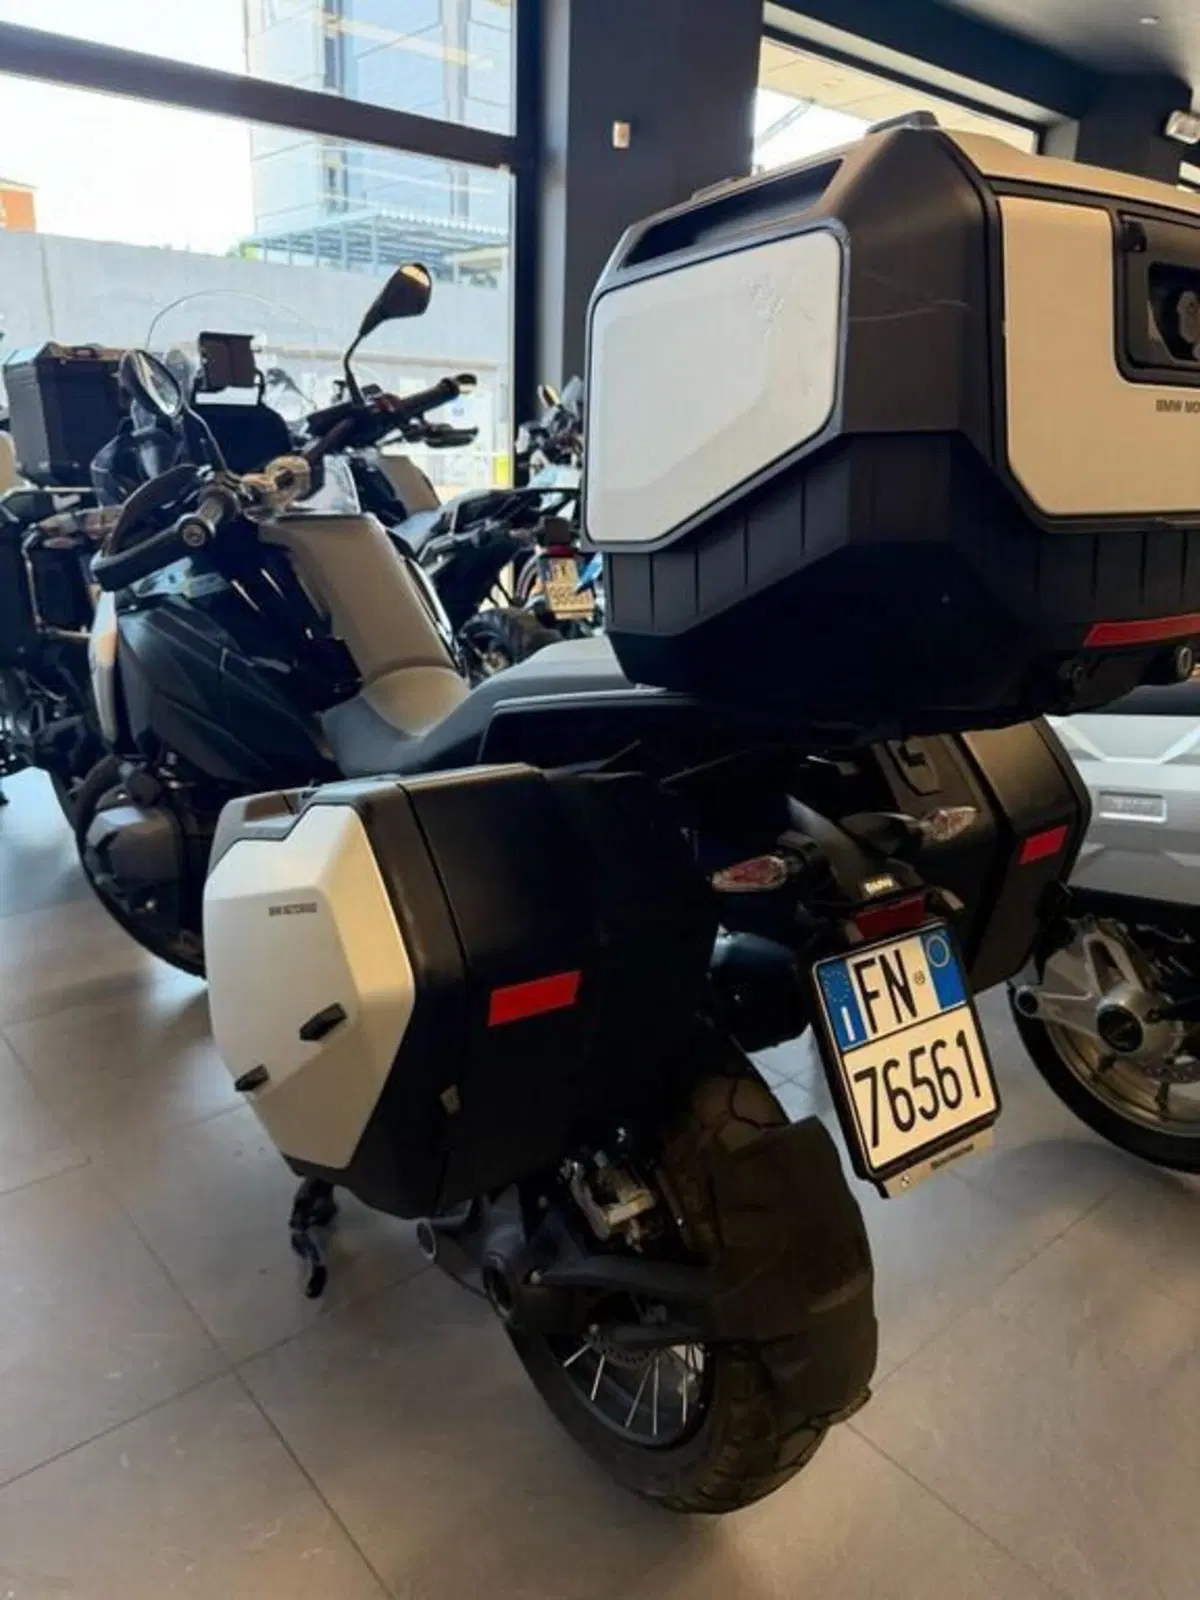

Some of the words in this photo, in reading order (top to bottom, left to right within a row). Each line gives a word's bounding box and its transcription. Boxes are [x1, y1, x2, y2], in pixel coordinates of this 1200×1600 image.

[1155, 399, 1182, 412] BMW
[853, 948, 917, 1034] FN
[854, 1029, 981, 1148] 76561
